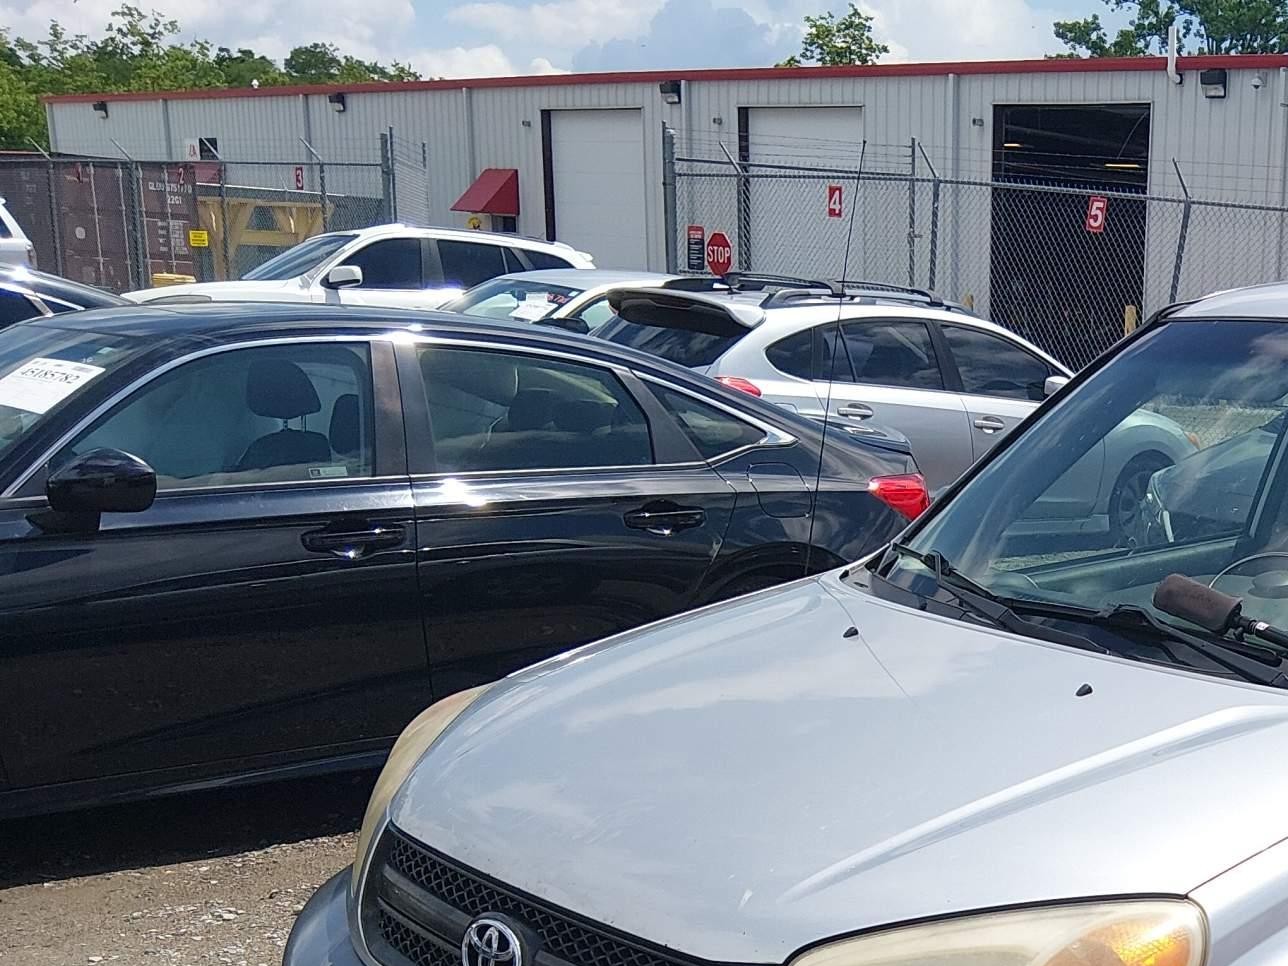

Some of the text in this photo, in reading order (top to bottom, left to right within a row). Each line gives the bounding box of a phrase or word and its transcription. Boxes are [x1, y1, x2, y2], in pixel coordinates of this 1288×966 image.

[178, 168, 184, 184] 2
[296, 169, 303, 188] 3
[829, 189, 841, 214] 4
[1089, 202, 1104, 228] 5
[707, 246, 731, 264] STOP
